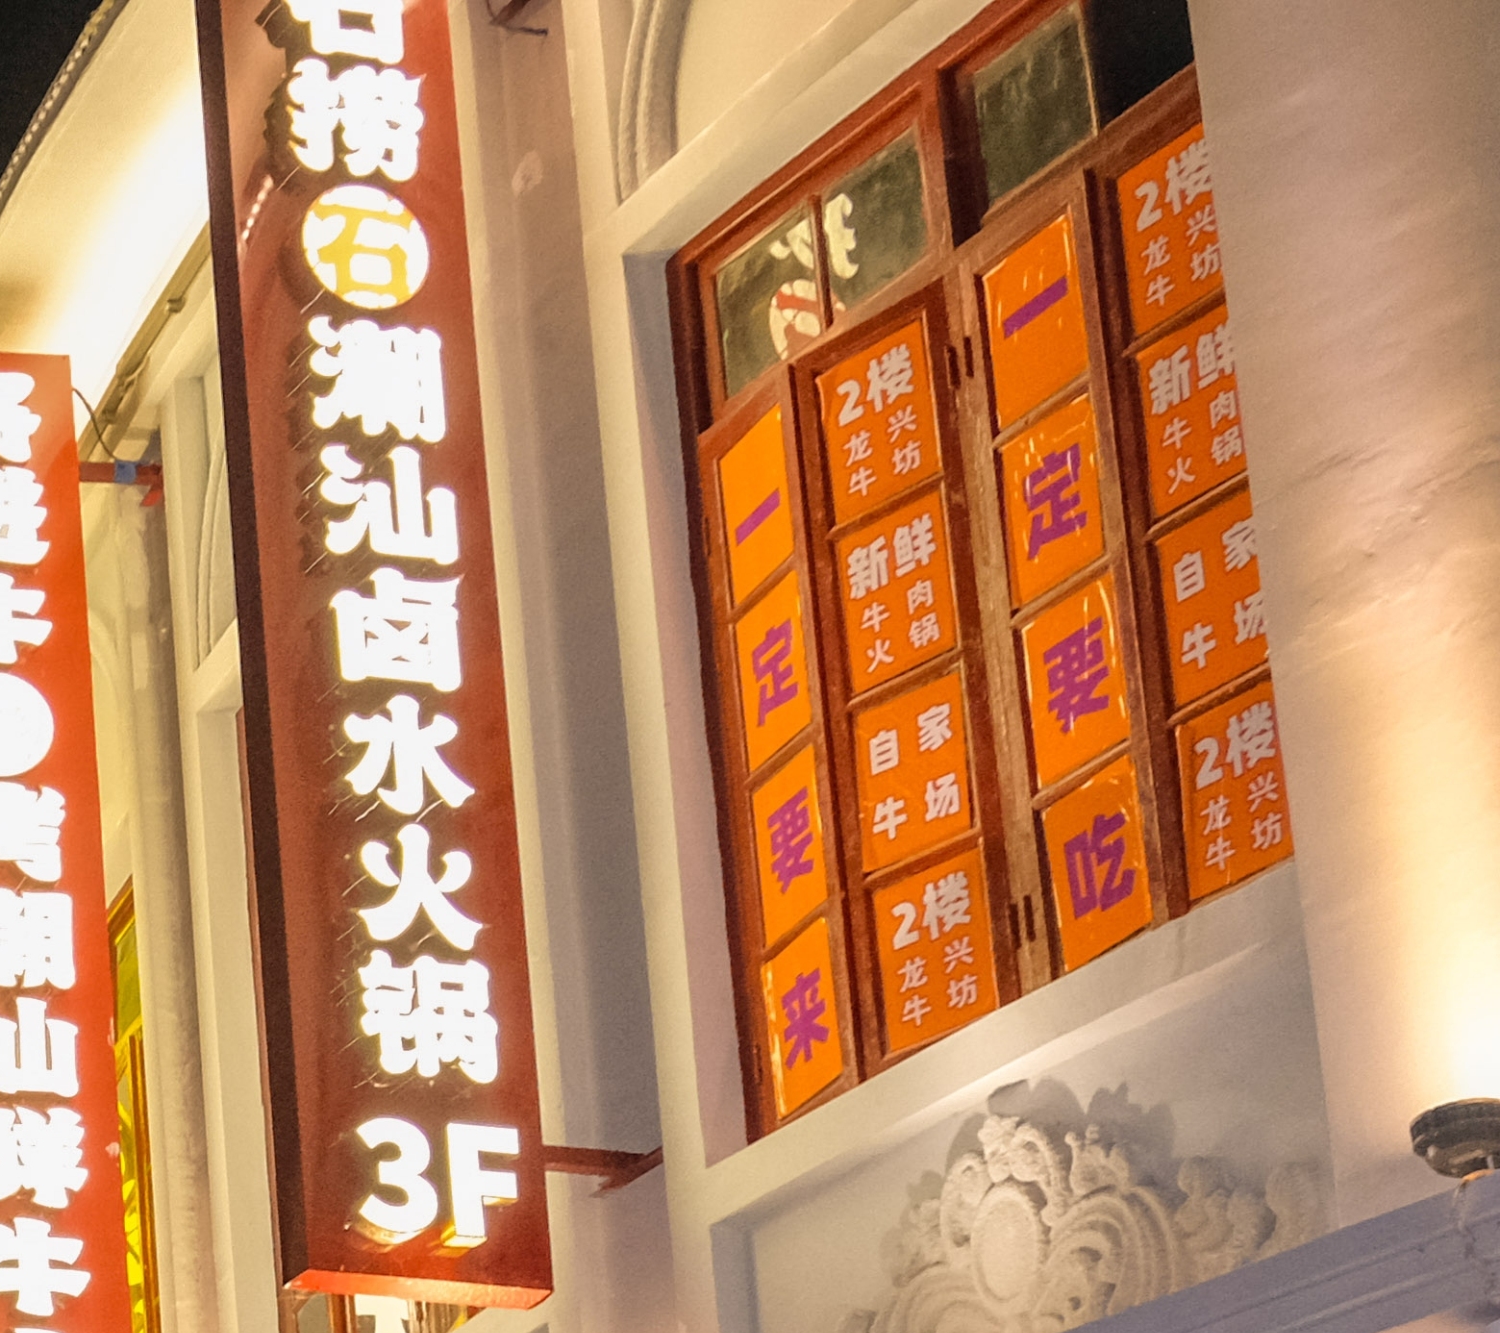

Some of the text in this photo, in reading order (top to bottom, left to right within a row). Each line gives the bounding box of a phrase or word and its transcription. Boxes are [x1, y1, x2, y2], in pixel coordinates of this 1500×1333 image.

[1134, 140, 1214, 233] 2楼
[1141, 207, 1216, 275] 龙兴
[1145, 241, 1221, 307] 牛坊
[836, 342, 915, 426] 2楼
[1148, 320, 1237, 418] 新鲜
[843, 403, 917, 469] 龙兴
[1162, 389, 1238, 449] 牛肉
[846, 438, 922, 500] 牛坊
[1166, 426, 1244, 495] 火锅
[846, 513, 936, 600] 新鲜
[1171, 517, 1259, 602] 自家
[860, 579, 934, 639] 牛肉
[1001, 276, 1137, 920] 一定要吃
[864, 614, 940, 673] 火锅
[1179, 599, 1268, 670] 牛场
[867, 702, 953, 775] 自家
[1192, 702, 1277, 790] 2楼
[734, 489, 830, 1070] 一定要来
[871, 770, 962, 840] 牛场
[1199, 770, 1277, 835] 龙兴
[1204, 810, 1283, 872] 牛坊
[890, 869, 973, 949] 2楼
[898, 936, 974, 996] 龙兴
[901, 972, 979, 1028] 牛坊
[357, 1116, 521, 1249] 3F
